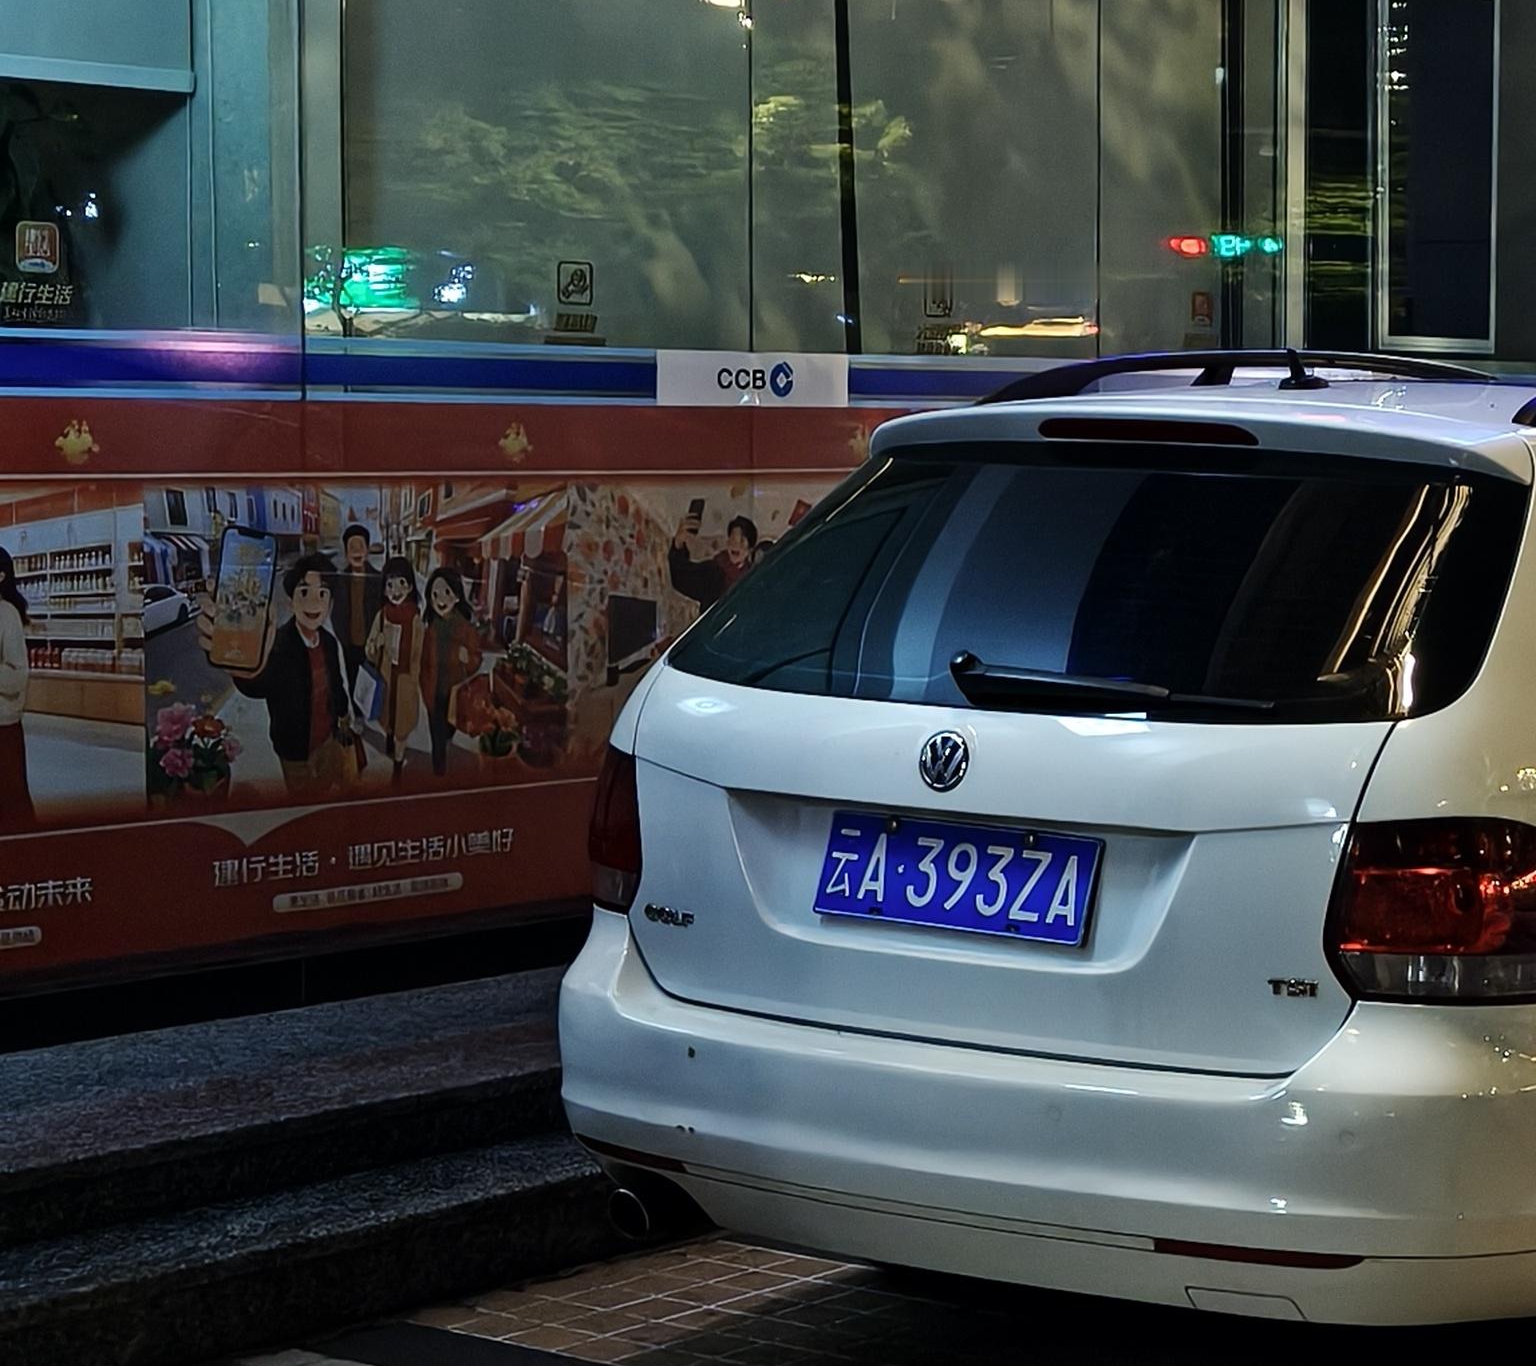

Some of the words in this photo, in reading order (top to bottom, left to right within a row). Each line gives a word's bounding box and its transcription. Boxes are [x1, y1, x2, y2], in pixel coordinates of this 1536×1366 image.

[0, 281, 73, 304] 建行生活
[717, 368, 767, 390] CCB
